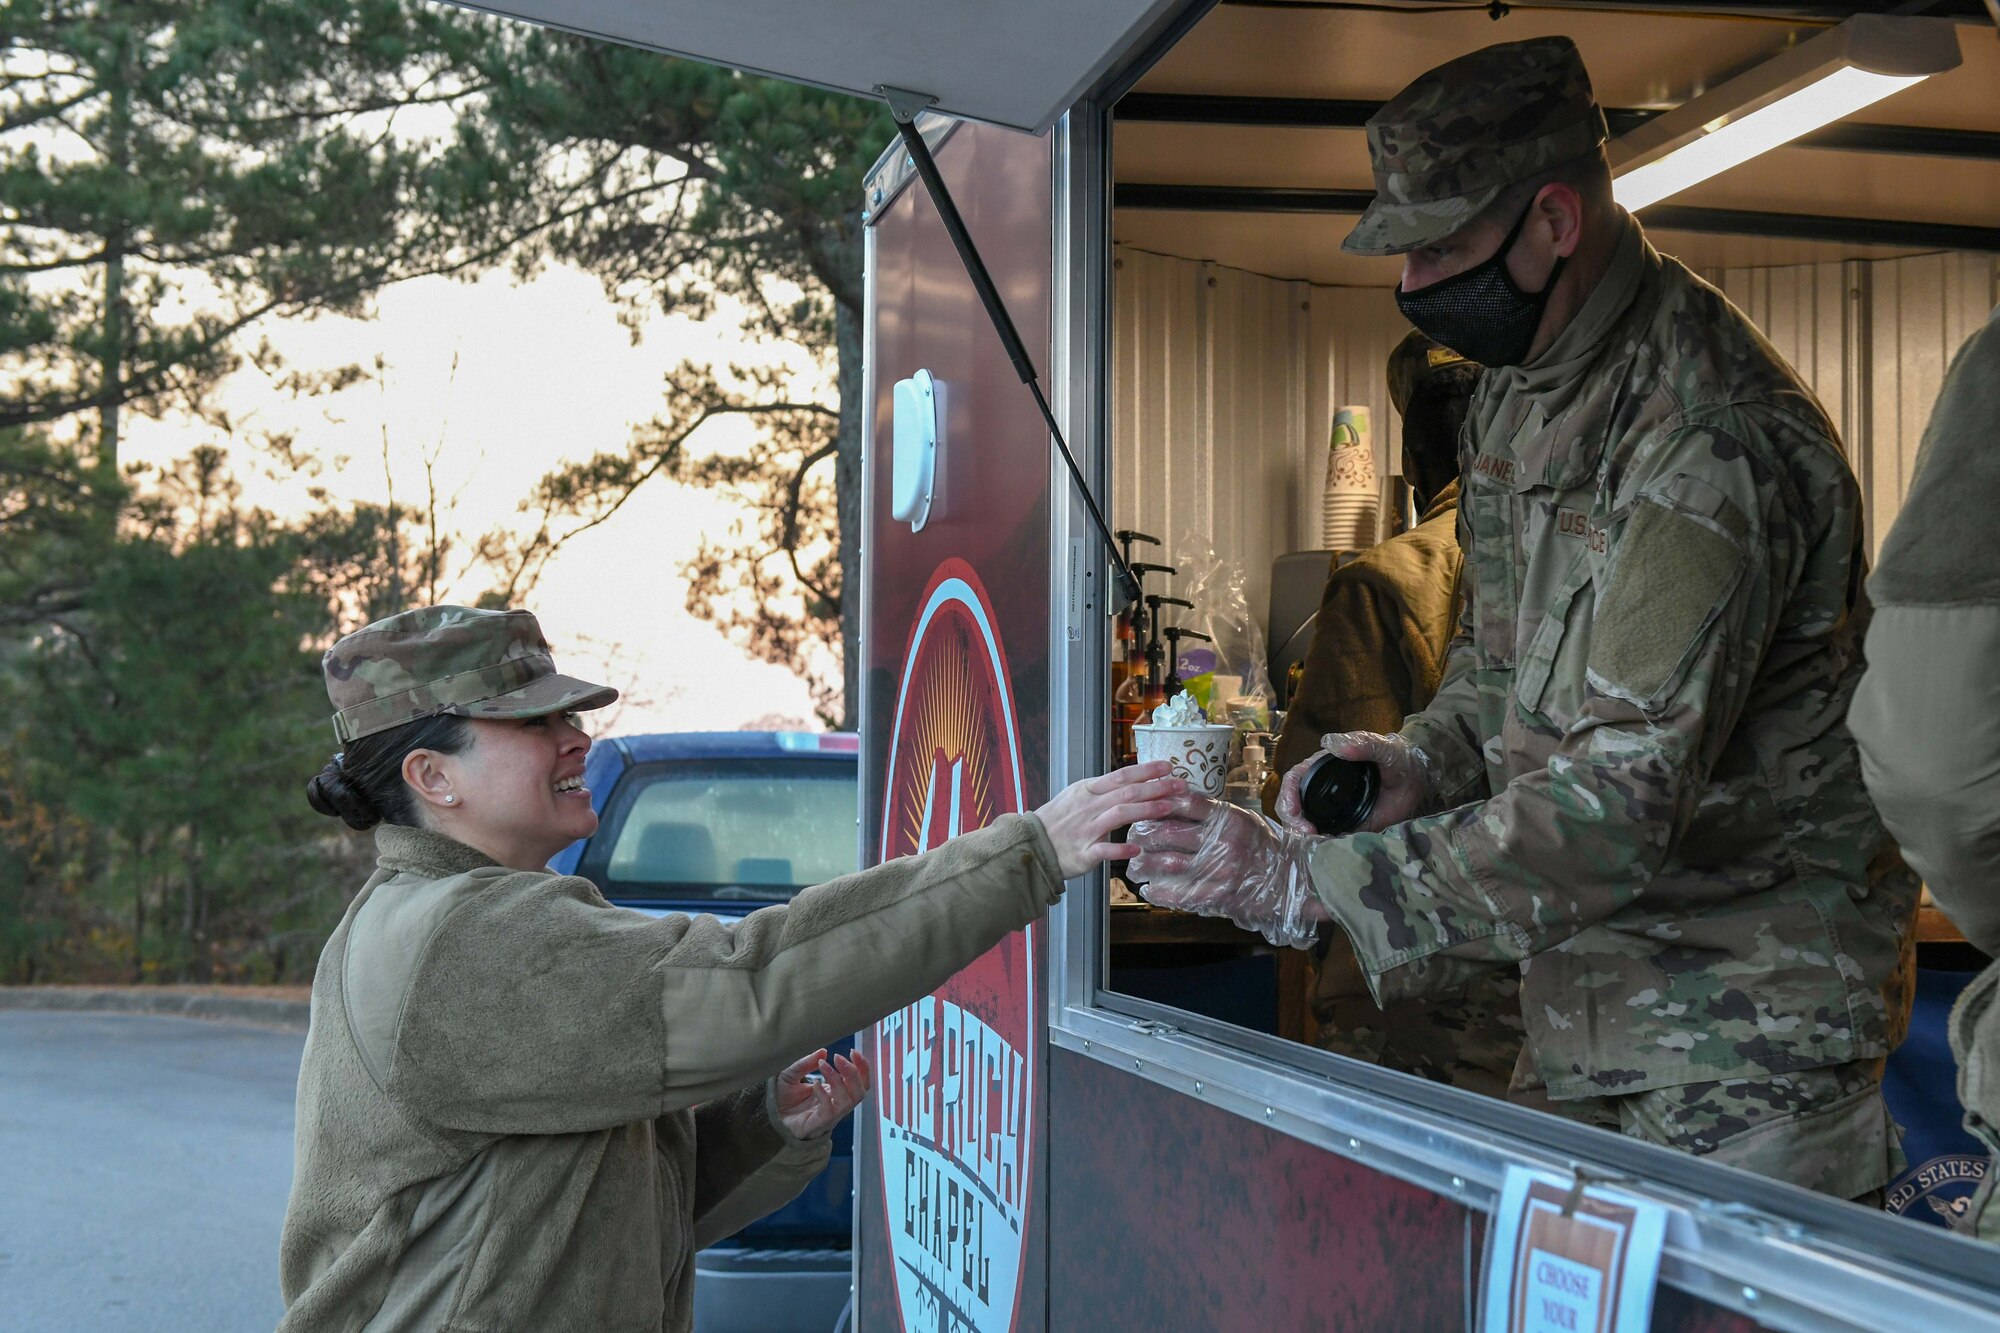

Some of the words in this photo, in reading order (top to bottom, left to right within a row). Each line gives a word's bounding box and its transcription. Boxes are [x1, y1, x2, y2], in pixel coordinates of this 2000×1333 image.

[882, 995, 936, 1142] THE
[942, 999, 1023, 1210] ROCK
[1917, 1160, 1984, 1189] STATES
[904, 1147, 990, 1307] CHAPEL
[1537, 1261, 1589, 1299] CHOOSE
[1542, 1297, 1577, 1331] YOUR
